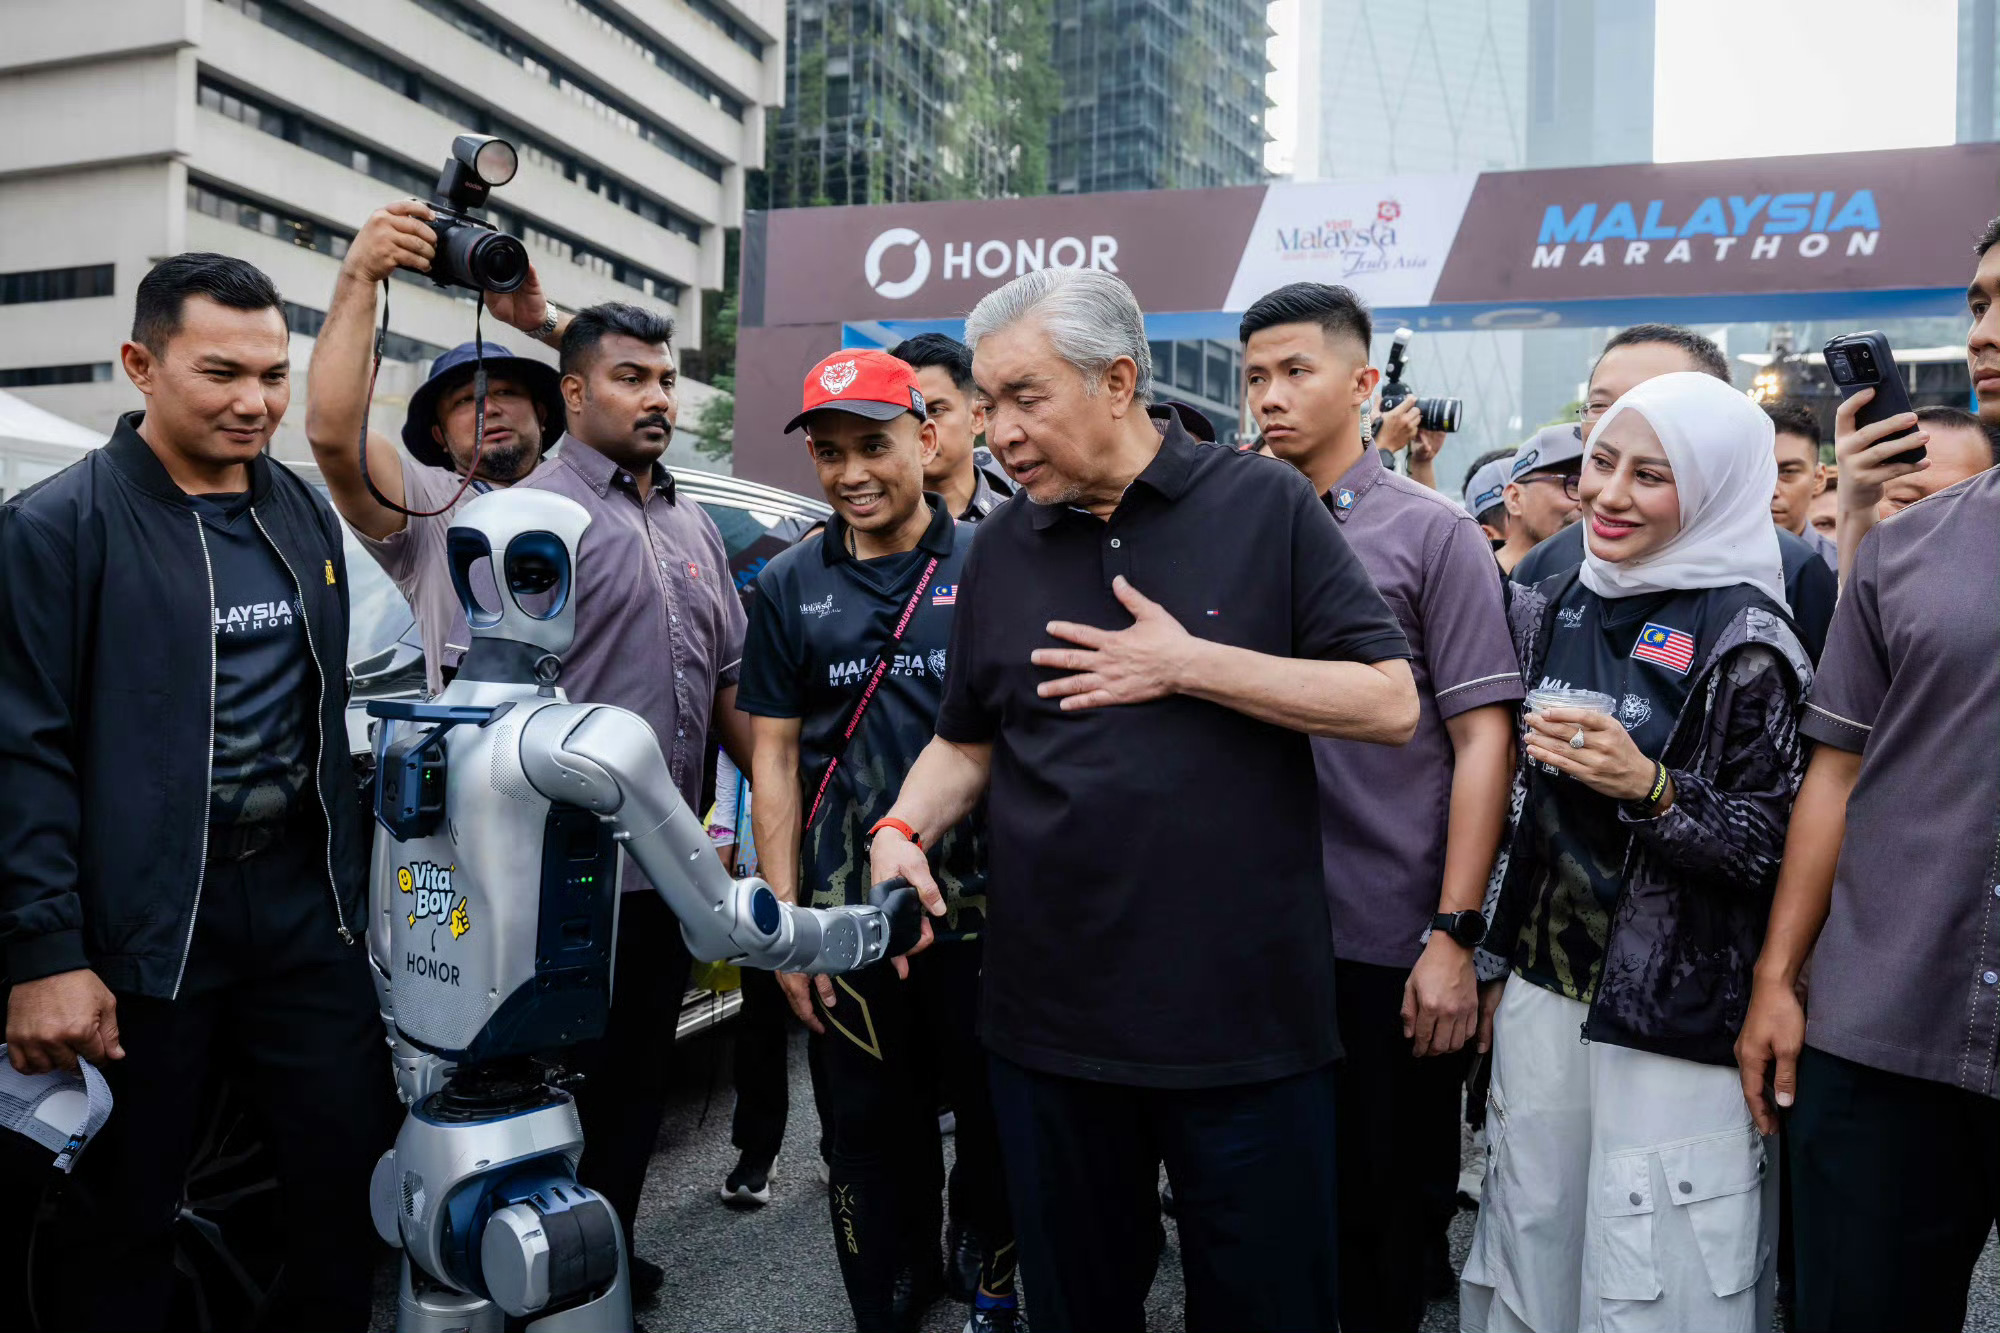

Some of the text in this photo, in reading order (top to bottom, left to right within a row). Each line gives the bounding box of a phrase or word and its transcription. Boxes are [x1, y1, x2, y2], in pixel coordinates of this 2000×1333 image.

[1537, 189, 1881, 244] MALAYSIA
[1277, 221, 1397, 252] Malaysia
[1532, 231, 1880, 269] MARATHON
[943, 235, 1119, 280] HONOR
[214, 600, 293, 624] LAYSIA
[893, 557, 938, 640] MALAYSIA MARATHON
[213, 615, 293, 634] RATHON
[829, 654, 925, 679] MALSIA
[829, 667, 925, 687] MARAHON
[844, 659, 887, 739] MALAYSIA MARATHON
[410, 861, 452, 891] Vita
[415, 888, 456, 925] Boy
[407, 951, 460, 987] HONOR
[842, 1217, 859, 1254] 2XU
